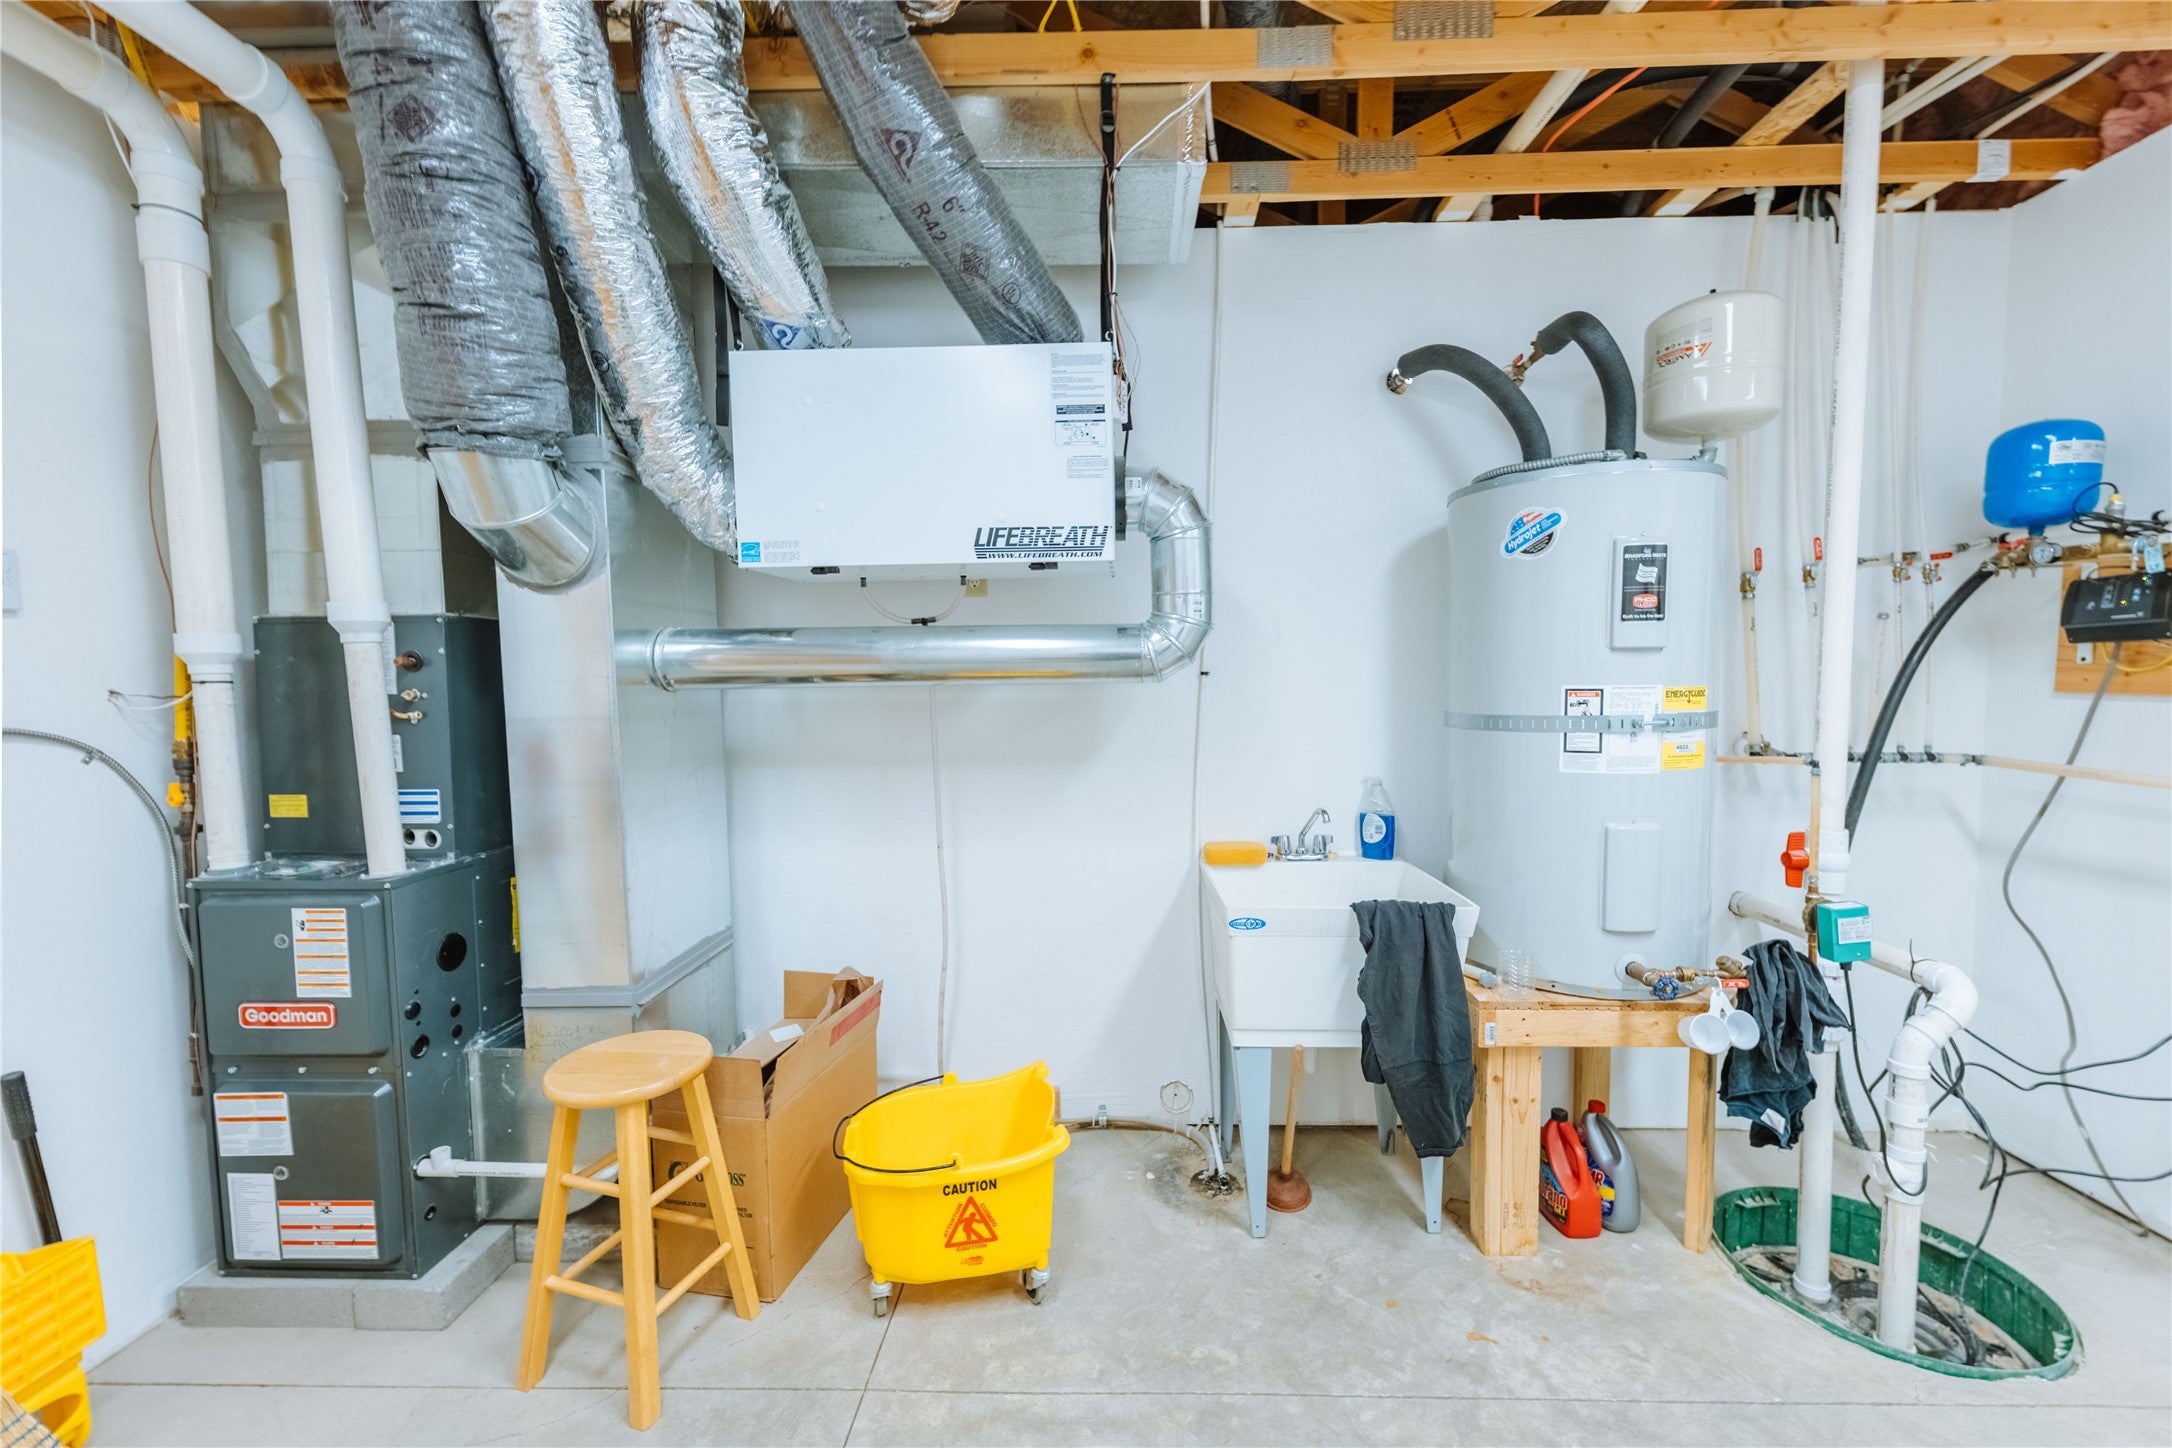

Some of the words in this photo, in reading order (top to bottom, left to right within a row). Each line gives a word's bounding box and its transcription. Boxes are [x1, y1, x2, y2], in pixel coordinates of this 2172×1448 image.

[914, 202, 947, 242] R-4.2
[974, 525, 1109, 548] LIFEBREATH
[1507, 523, 1541, 551] Hydrojet
[988, 551, 1103, 559] WWW.LIFEBREATH.COM
[244, 1008, 328, 1023] Goodman
[943, 1179, 998, 1196] CAUTION
[944, 1203, 963, 1237] ATTENTION
[980, 1203, 998, 1227] CUIDADO
[957, 1243, 987, 1252] CAUTION
